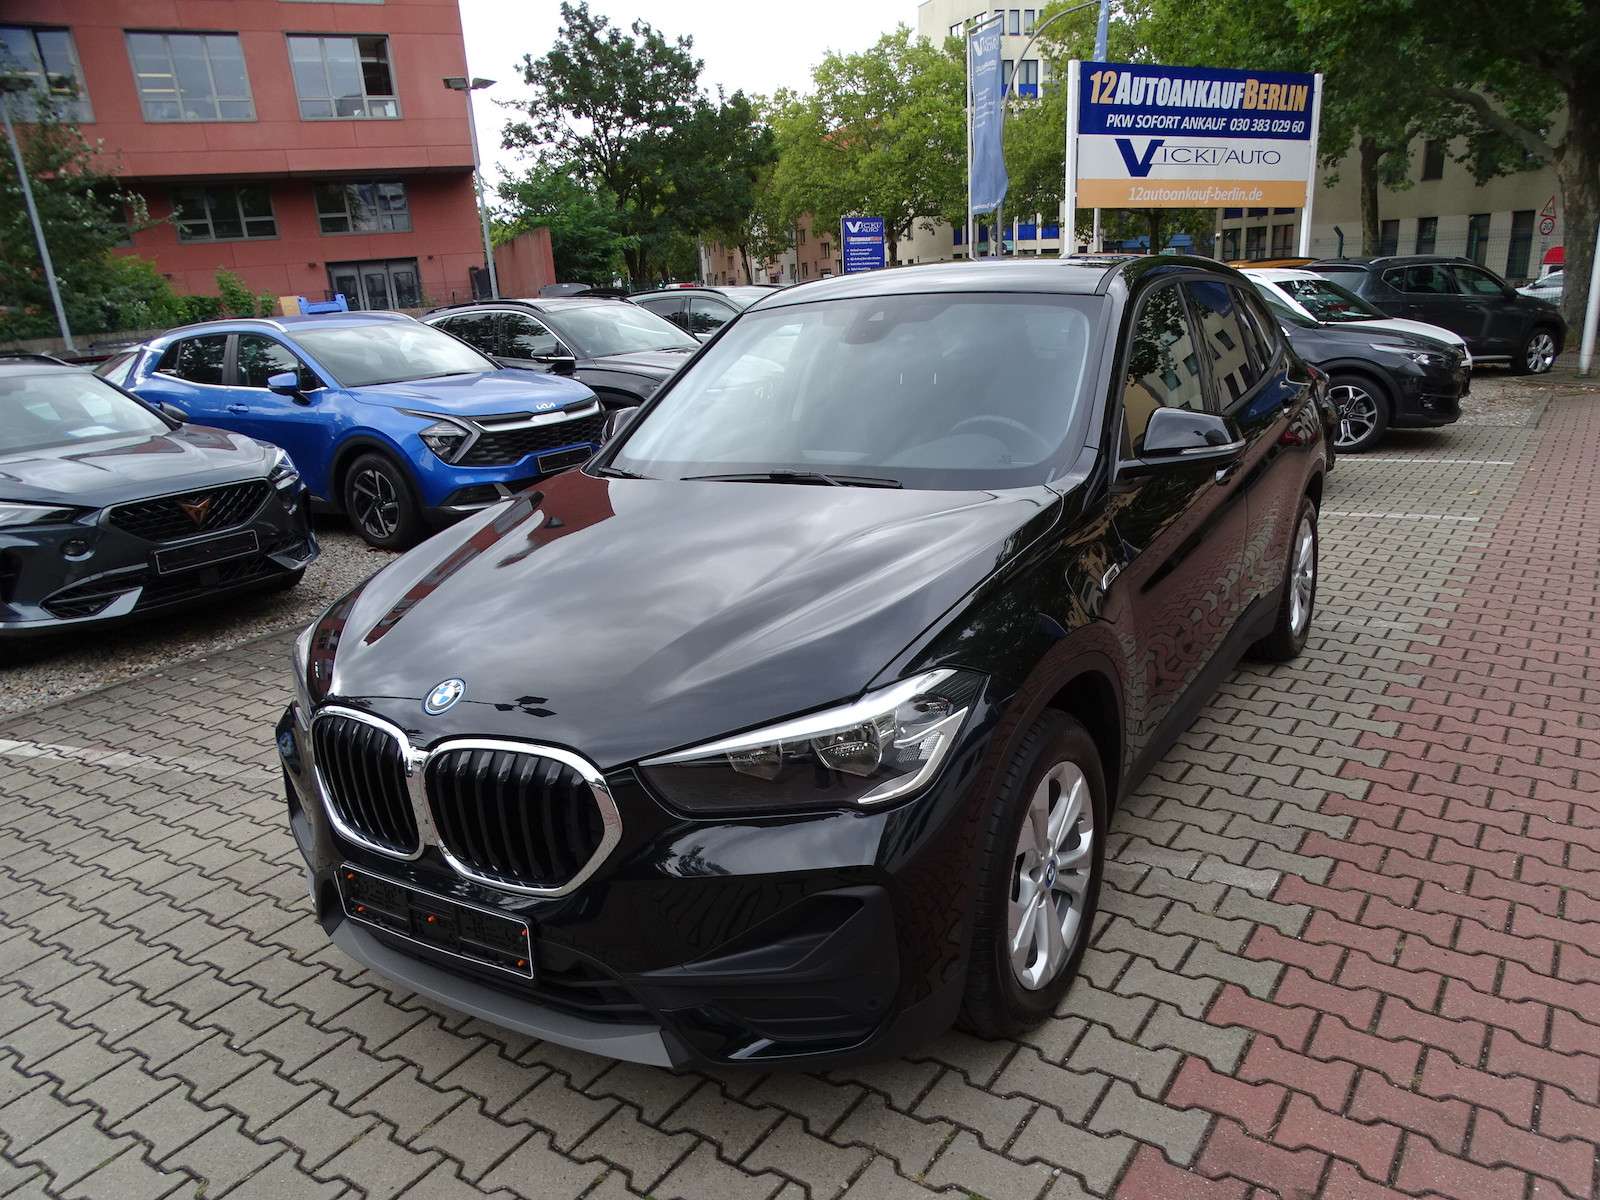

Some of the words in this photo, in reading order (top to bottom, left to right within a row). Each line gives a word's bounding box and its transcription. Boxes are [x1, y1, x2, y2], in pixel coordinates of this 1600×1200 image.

[1106, 113, 1135, 128] PKW
[1135, 114, 1181, 129] SOFORT
[1180, 116, 1228, 131] ANKAUF
[1230, 118, 1250, 131] 030
[1250, 118, 1271, 132] 383
[1271, 119, 1291, 133] 029
[1291, 120, 1305, 133] 60
[1225, 149, 1281, 165] AUTO
[1128, 186, 1264, 204] 12autoankauf-berlin.de
